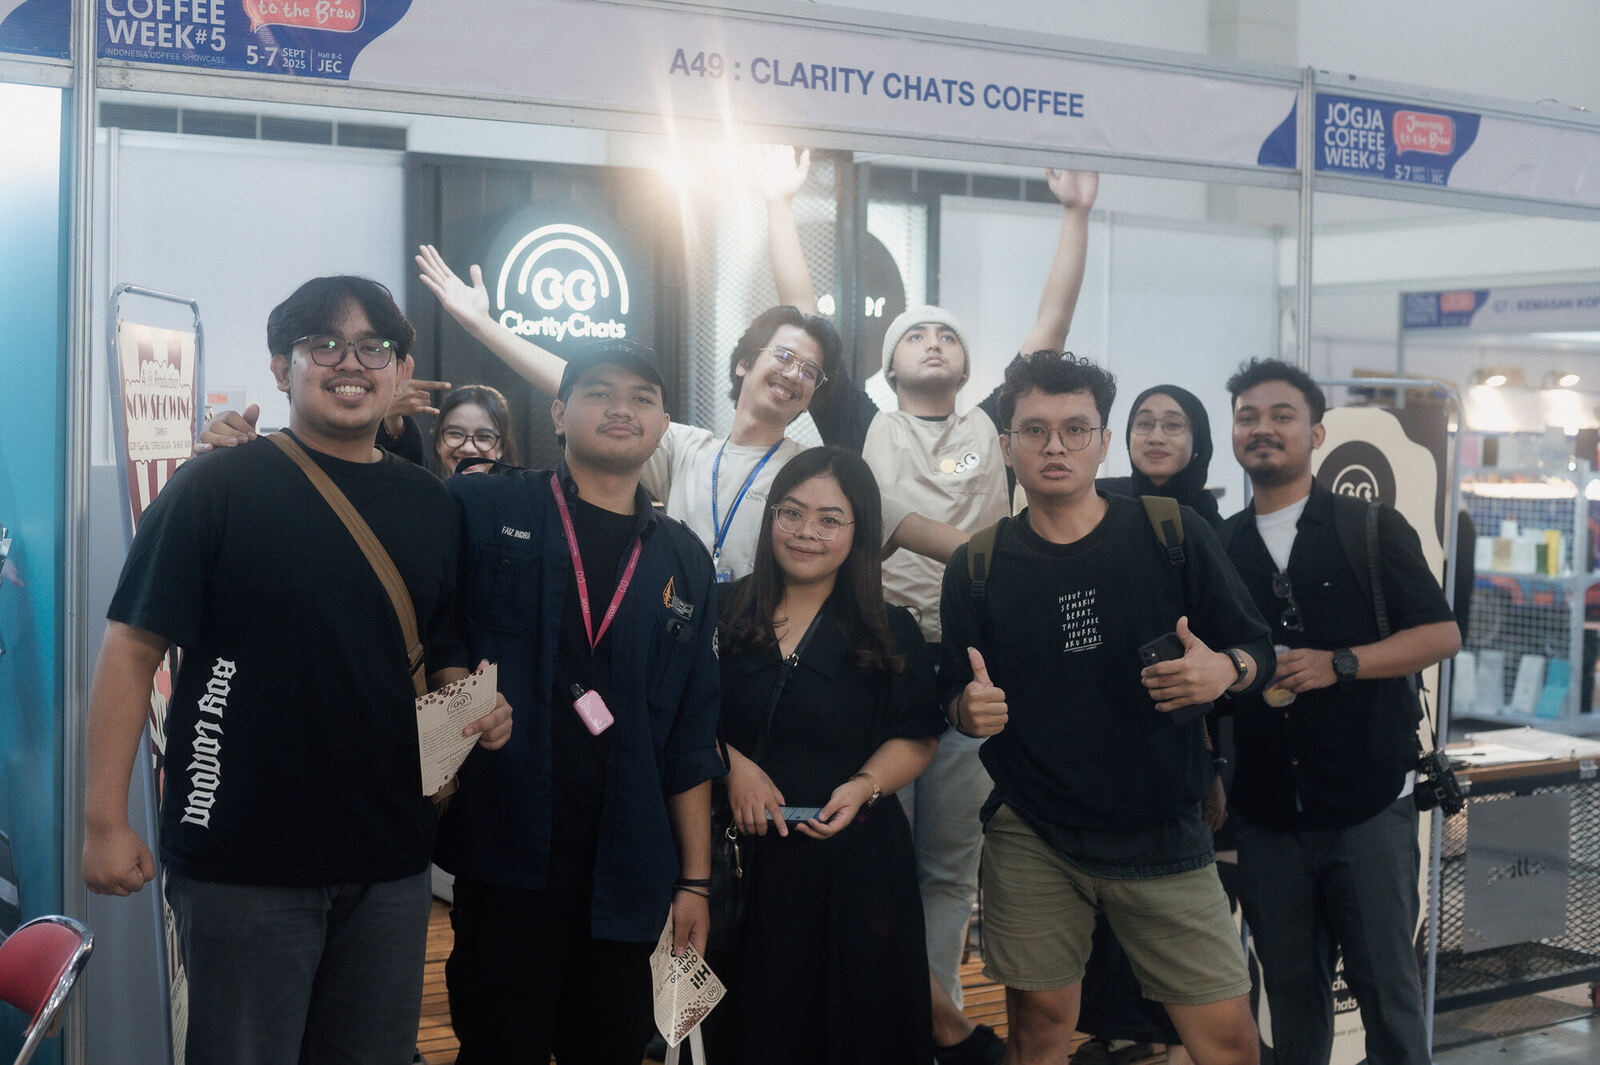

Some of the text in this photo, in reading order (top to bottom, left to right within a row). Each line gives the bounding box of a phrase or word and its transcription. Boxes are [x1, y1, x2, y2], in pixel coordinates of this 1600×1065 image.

[105, 0, 226, 25] COFFEE
[257, 0, 356, 24] to the Brew
[104, 48, 226, 64] INDONESIA COFFEE SHOWCASE
[246, 45, 279, 67] 5-7
[281, 47, 306, 59] SEPT
[281, 58, 306, 70] 2025
[317, 59, 342, 73] JEC
[669, 48, 725, 80] A49
[750, 57, 875, 96] CLARITY
[883, 72, 976, 107] CHATS
[983, 83, 1085, 118] COFFEE
[1324, 102, 1385, 131] JOGJA
[1324, 126, 1386, 151] COFFEE
[126, 392, 192, 421] NOW SHOWING
[1058, 590, 1081, 604] HIDUP
[1061, 598, 1095, 612] SEMAKIN
[680, 954, 698, 974] OUR
[690, 963, 712, 990] Hi!
[1333, 996, 1359, 1012] hats
